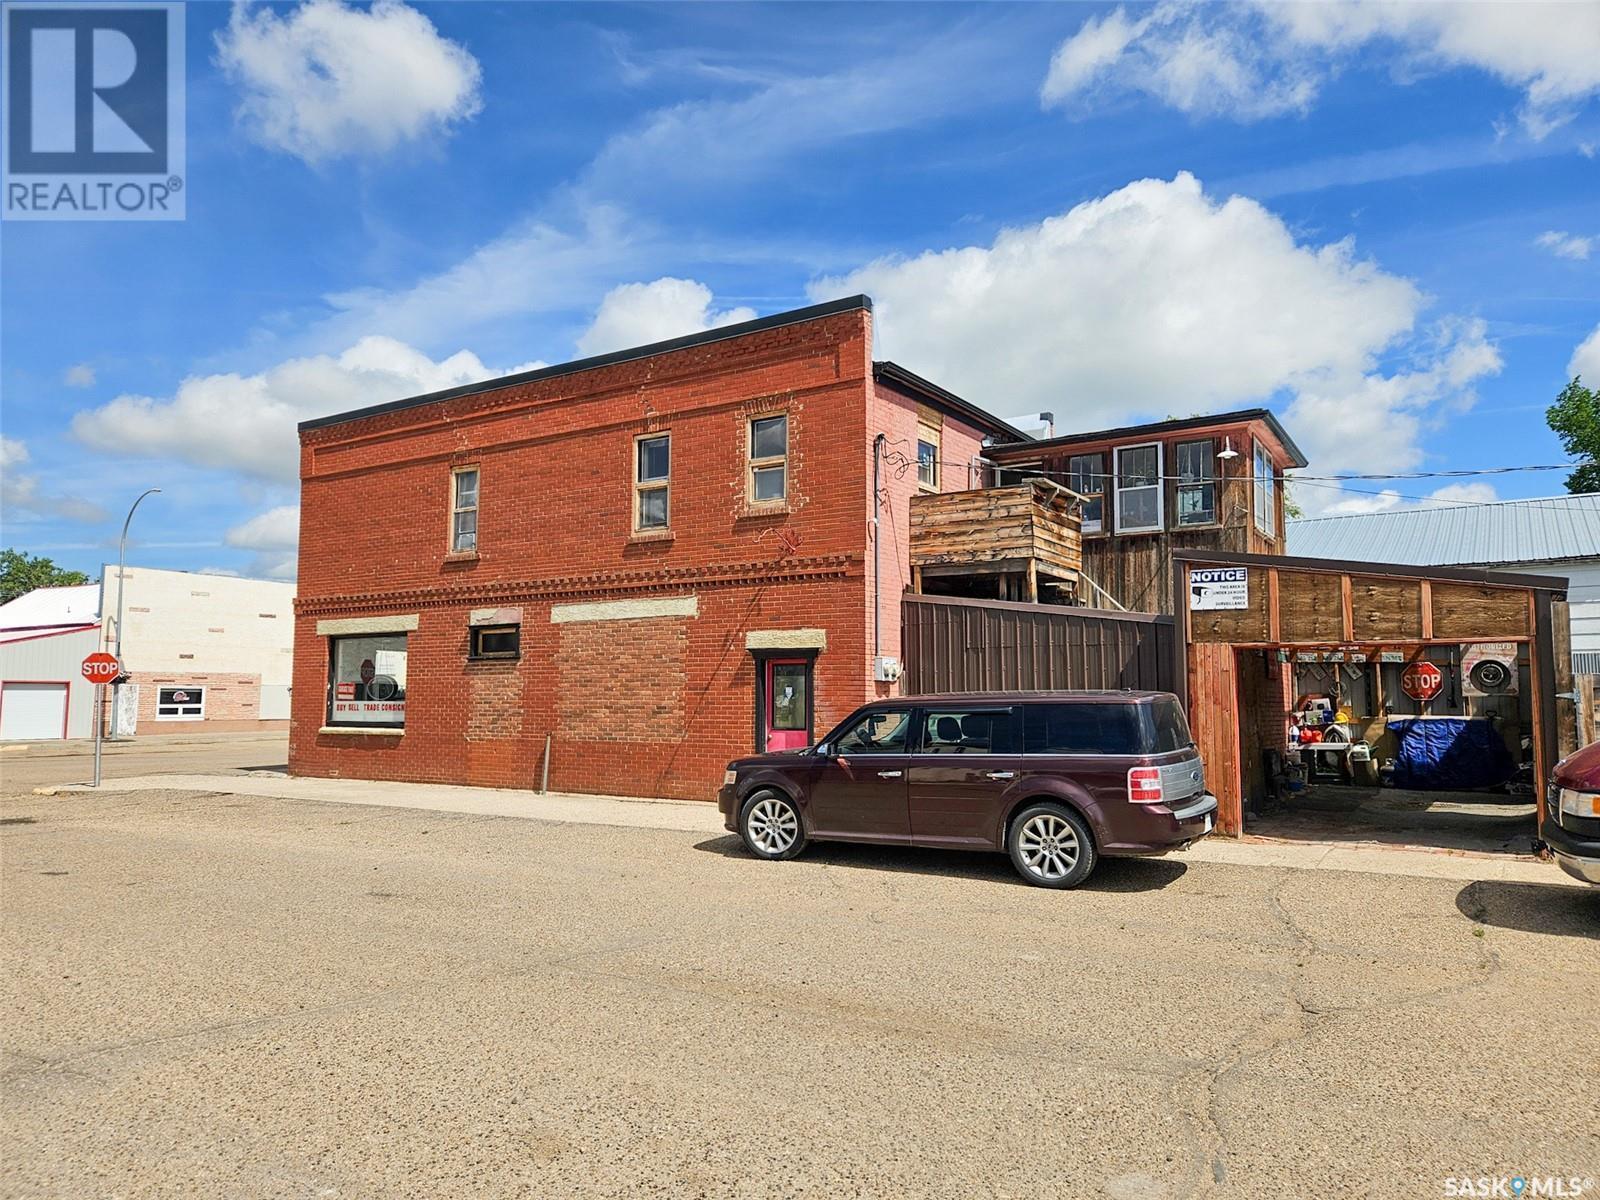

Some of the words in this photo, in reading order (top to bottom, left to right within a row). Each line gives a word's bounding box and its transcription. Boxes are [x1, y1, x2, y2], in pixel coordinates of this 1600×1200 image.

[1191, 570, 1245, 582] NOTICE
[82, 662, 118, 675] STOP
[1403, 674, 1441, 689] STOP
